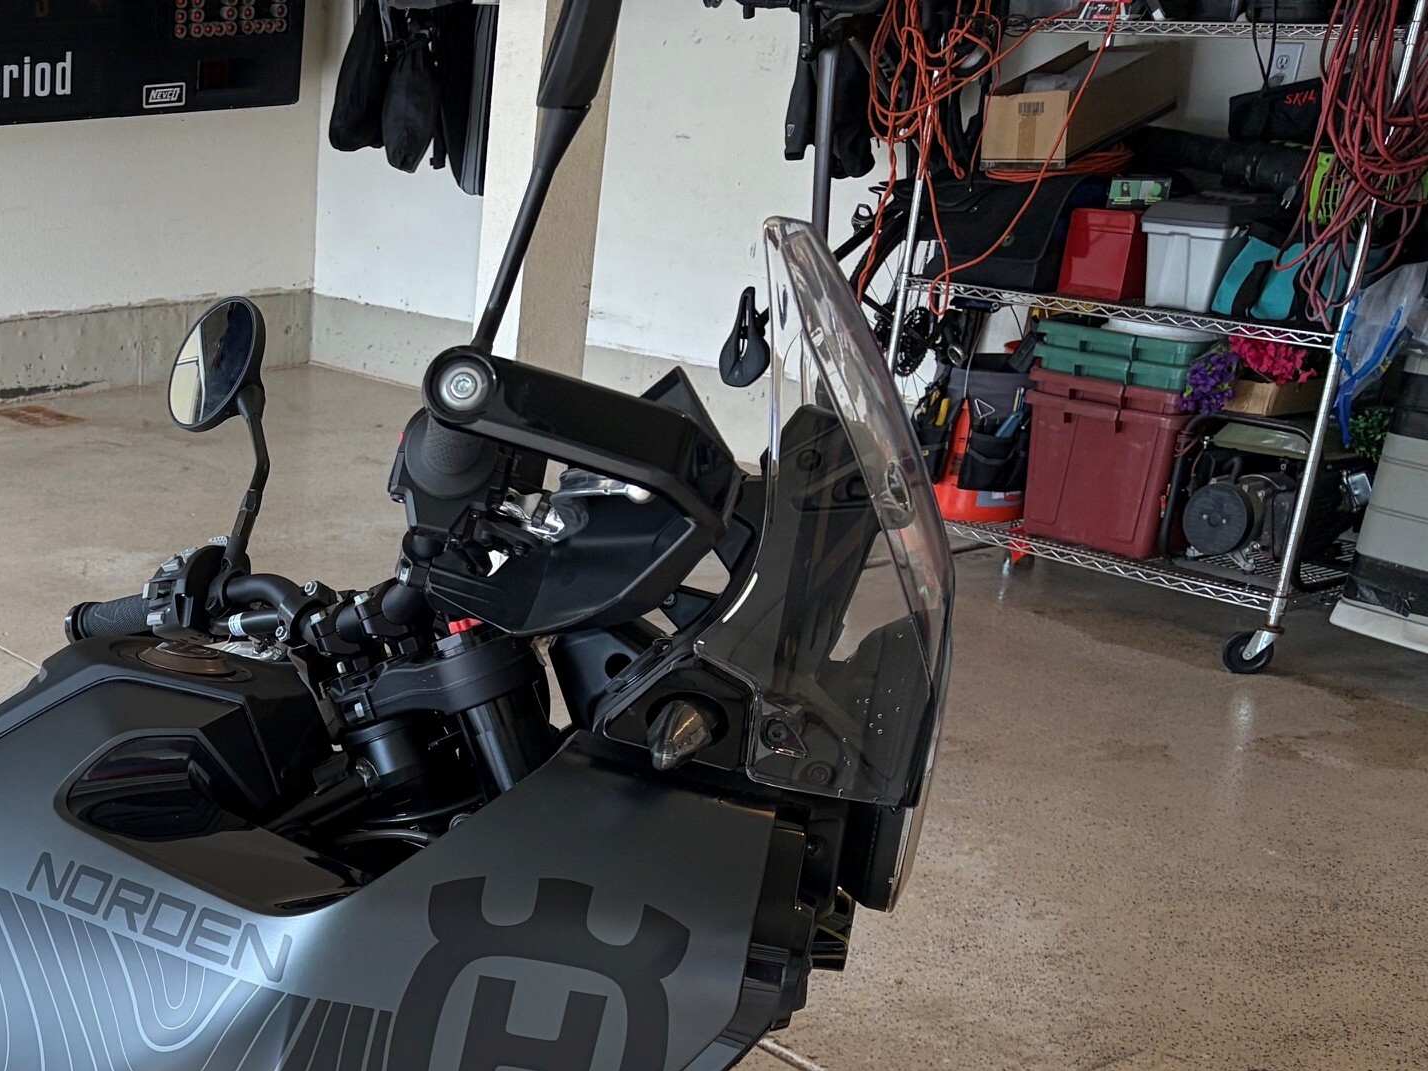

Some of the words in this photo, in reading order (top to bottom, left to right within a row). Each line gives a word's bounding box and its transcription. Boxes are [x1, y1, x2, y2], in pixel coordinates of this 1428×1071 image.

[148, 87, 181, 103] NEVCO
[1285, 89, 1316, 107] SKIL
[26, 851, 293, 983] NORDEN
